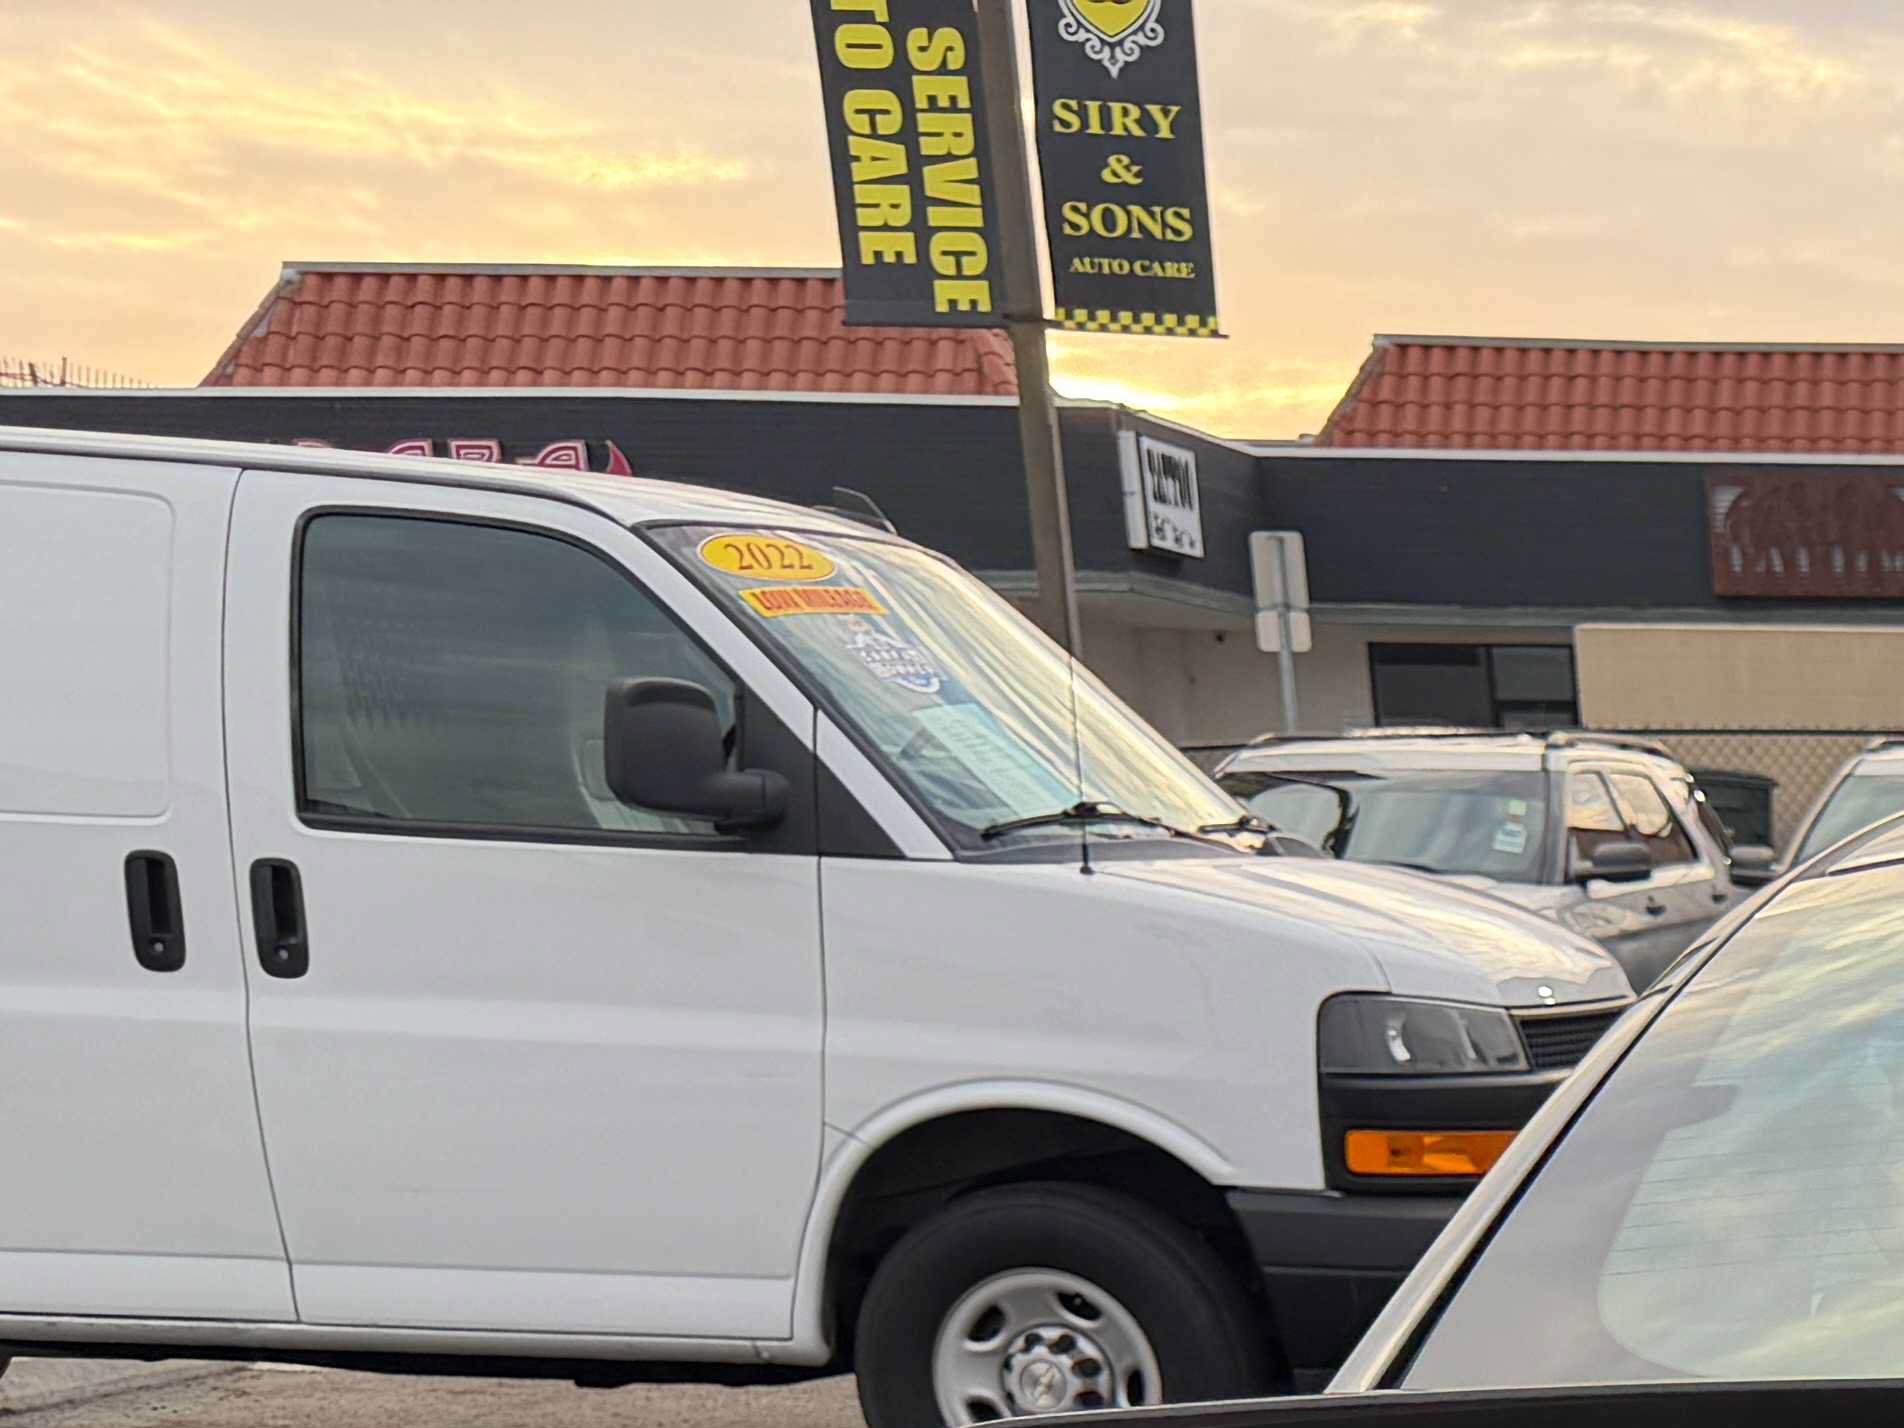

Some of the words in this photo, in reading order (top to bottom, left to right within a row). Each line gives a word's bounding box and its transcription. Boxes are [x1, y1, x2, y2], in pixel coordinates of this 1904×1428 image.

[1052, 98, 1181, 139] SIRY
[843, 89, 917, 265] CARE
[906, 27, 992, 313] SERVICE
[1101, 153, 1143, 185] &
[1061, 200, 1194, 242] SONS
[1070, 255, 1129, 276] AUTO
[1133, 259, 1195, 279] CARE
[724, 541, 814, 571] 2022
